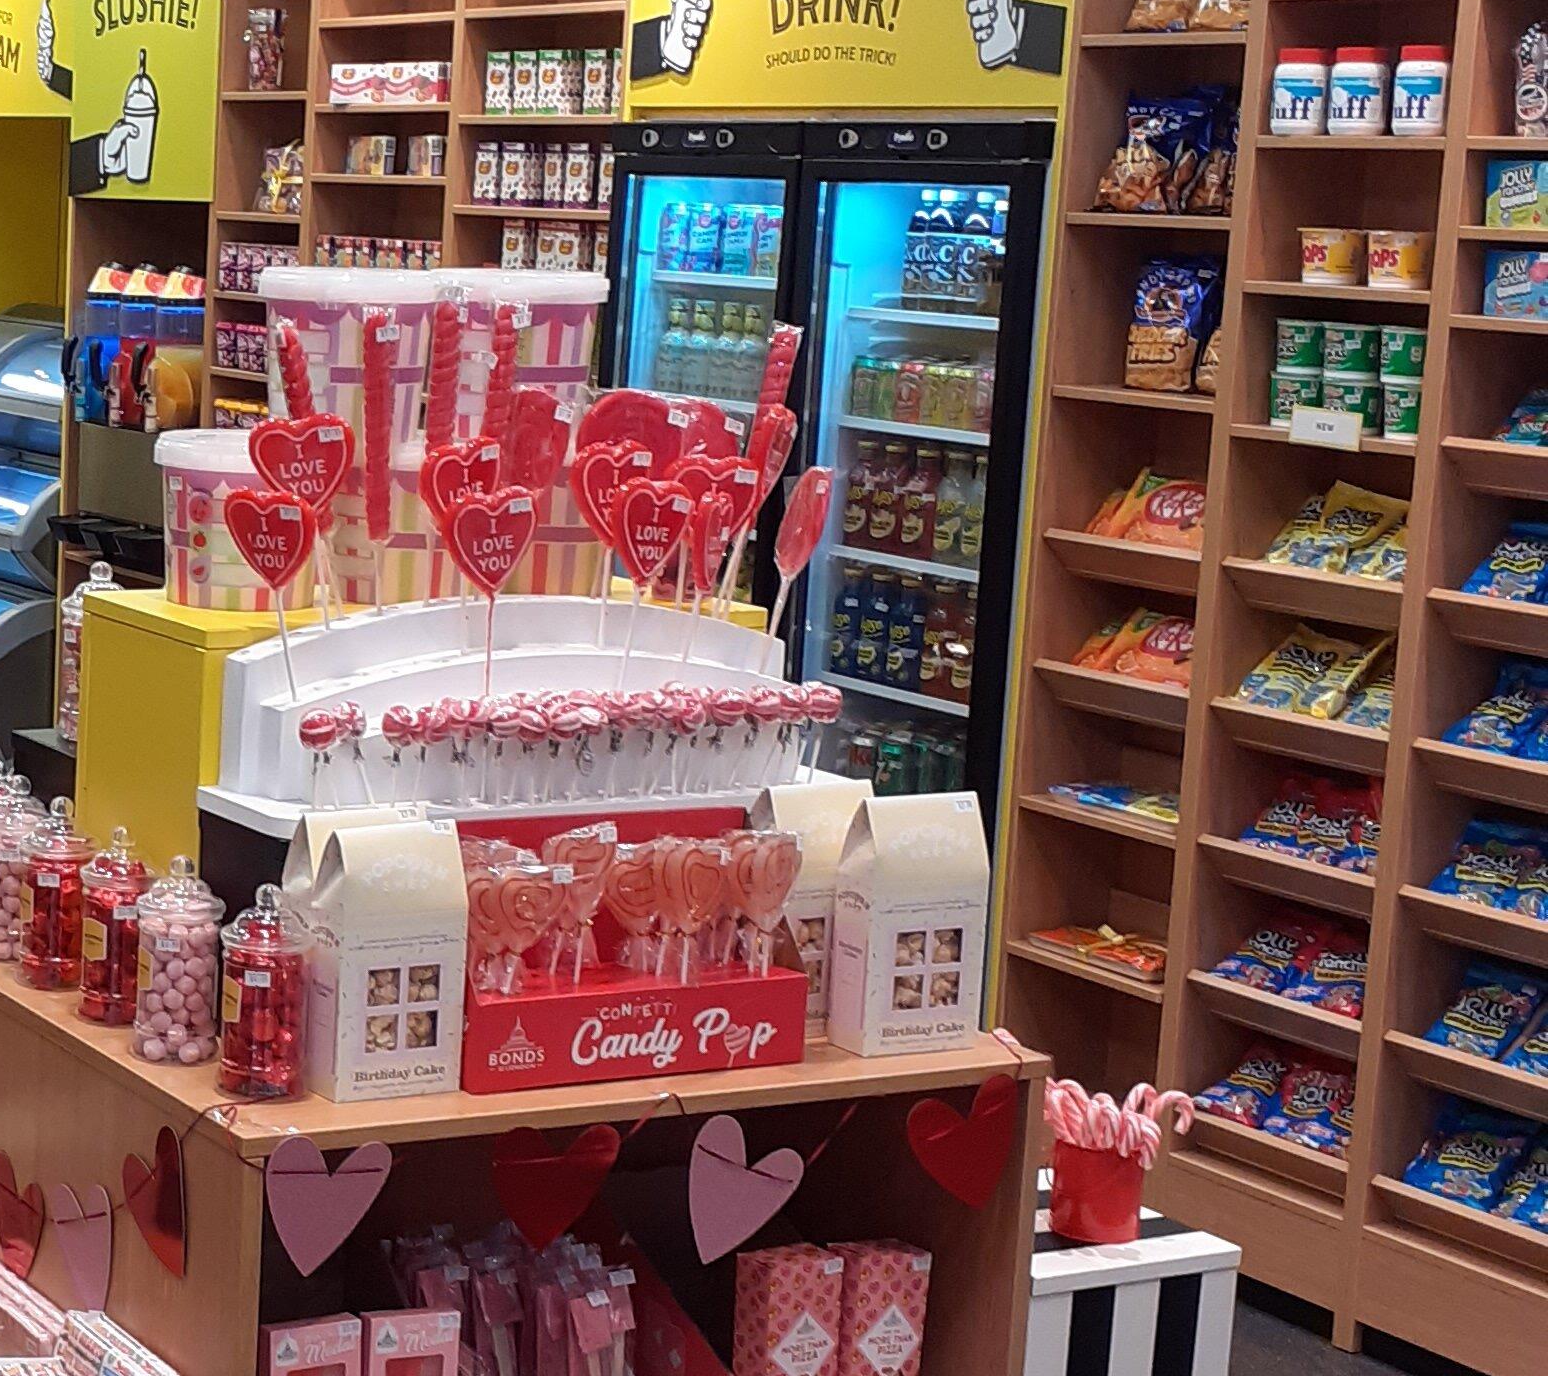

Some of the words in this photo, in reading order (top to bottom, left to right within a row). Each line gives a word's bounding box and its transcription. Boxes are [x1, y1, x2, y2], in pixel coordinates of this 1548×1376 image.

[766, 47, 810, 69] SHOULD
[813, 46, 831, 61] DO
[834, 46, 856, 61] THE
[859, 47, 897, 66] TRICK!
[1272, 96, 1314, 121] uff
[1332, 95, 1370, 121] uff
[1394, 95, 1430, 120] uff
[1502, 167, 1532, 187] JOLLY
[1302, 244, 1328, 263] OPS
[1498, 260, 1528, 278] JOLLY
[1316, 422, 1335, 432] NEW
[295, 444, 304, 459] I
[279, 459, 328, 479] LOVE
[463, 469, 469, 483] I
[613, 469, 619, 484] I
[288, 479, 325, 496] YOU
[598, 488, 619, 504] LO
[261, 517, 268, 531] I
[653, 508, 659, 523] I
[491, 519, 497, 534] I
[636, 525, 670, 543] LOVE
[248, 535, 288, 552] LOVE
[473, 535, 515, 556] LOVE
[255, 552, 285, 569] YOU
[637, 545, 663, 560] YOU
[479, 556, 511, 573] YOU
[1249, 939, 1293, 958] ancher
[1256, 930, 1298, 951] OLLY
[882, 1025, 932, 1039] Birthday
[937, 1022, 965, 1034] Cake
[571, 1017, 683, 1068] Candy
[488, 1049, 545, 1066] BONDS
[353, 1067, 411, 1083] Birthday
[414, 1064, 446, 1076] Cake
